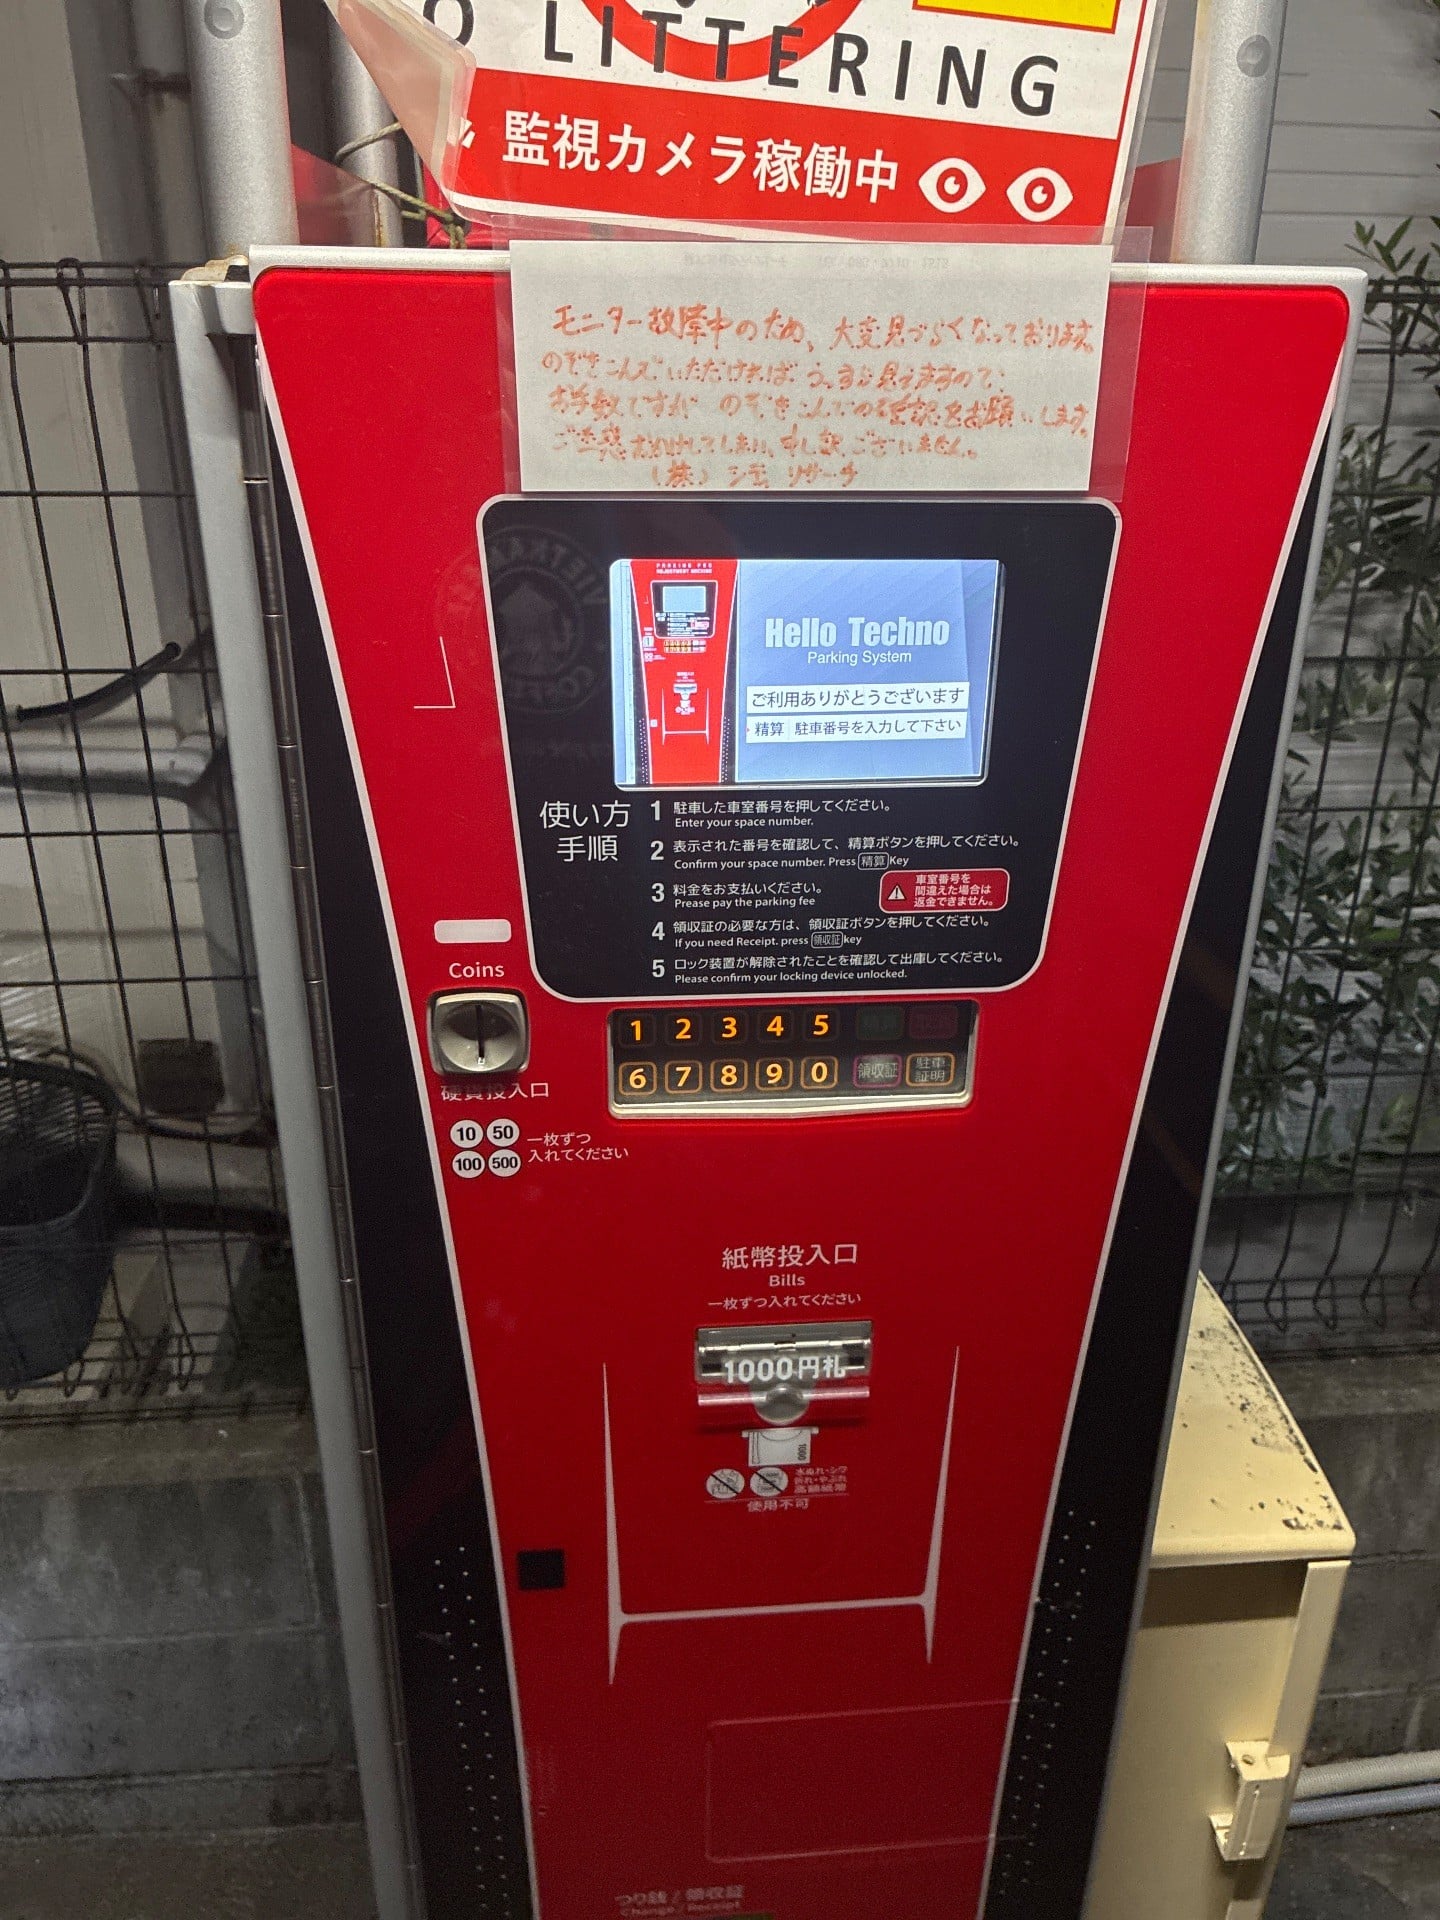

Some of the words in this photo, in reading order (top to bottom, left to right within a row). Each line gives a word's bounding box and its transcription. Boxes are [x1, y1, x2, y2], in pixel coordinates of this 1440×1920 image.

[544, 0, 1059, 117] LITTERING
[502, 110, 899, 204] 監視カメラ稼働中
[765, 617, 837, 648] Hello
[848, 616, 950, 648] Techno
[807, 651, 858, 667] Parking
[862, 650, 912, 666] System
[752, 688, 965, 708] ご利用ありがとうございます
[755, 721, 785, 737] 精算
[795, 718, 962, 736] 駐車番号を入力して下さい
[539, 800, 631, 829] 使い方
[651, 800, 661, 822] 1
[673, 798, 890, 815] 駐車した車室番号を押してください。
[675, 818, 704, 828] Enter
[707, 819, 731, 830] your
[735, 818, 765, 828] space
[769, 816, 814, 827] number.
[556, 834, 618, 863] 手順
[650, 840, 664, 861] 2
[673, 834, 1020, 853] 表示された番号を確認して、精算ボタンを押してください。
[674, 859, 718, 870] Confirm
[720, 860, 745, 871] your
[748, 860, 779, 870] space
[781, 857, 826, 868] number.
[828, 857, 856, 867] Press
[861, 856, 886, 868] 精算
[889, 856, 909, 868] Key
[915, 873, 971, 885] 車室番号を
[651, 883, 665, 903] 3
[673, 882, 822, 897] 料金をお支払いください。
[914, 885, 991, 896] 間違えた場合は
[674, 899, 710, 909] Prease
[713, 900, 732, 910] pay
[735, 898, 752, 907] the
[755, 897, 797, 909] parking
[799, 896, 816, 906] fee
[913, 896, 993, 908] 返金できません。
[651, 921, 665, 941] 4
[673, 914, 990, 934] 領収証の必要な方は、領収証ボタンを押してください。
[675, 938, 682, 948] If
[684, 939, 704, 950] you
[707, 937, 733, 947] need
[736, 937, 779, 948] Receipt.
[781, 937, 808, 947] press
[813, 934, 841, 946] 領収証
[843, 935, 862, 946] key
[448, 960, 505, 979] Coins
[652, 959, 665, 978] 5
[674, 951, 1003, 970] ロック装置が解除されたことを確認して出庫してください。
[675, 974, 709, 984] Please
[711, 973, 751, 983] confirm
[754, 974, 777, 984] your
[780, 971, 818, 983] locking
[821, 971, 854, 980] device
[857, 969, 907, 980] unlocked.
[630, 1020, 641, 1041] 1
[675, 1018, 692, 1039] 2
[721, 1016, 737, 1038] 3
[766, 1015, 784, 1037] 4
[813, 1014, 829, 1036] 5
[858, 1062, 898, 1079] 領収証
[915, 1057, 946, 1069] 駐車
[629, 1068, 647, 1089] 6
[675, 1066, 692, 1087] 7
[720, 1064, 738, 1086] 8
[765, 1063, 783, 1084] 9
[811, 1061, 828, 1083] 0
[915, 1070, 945, 1083] 証明
[456, 1126, 476, 1141] 10
[492, 1125, 514, 1140] 50
[526, 1132, 591, 1147] 一枚ずつ
[455, 1157, 482, 1171] 100
[491, 1156, 519, 1169] 500
[528, 1147, 629, 1163] 入れてください
[721, 1243, 858, 1270] 紙幣投入口
[768, 1274, 806, 1287] Bills
[708, 1293, 862, 1310] 一枚ずつ入れてください
[724, 1354, 846, 1384] 1000円札
